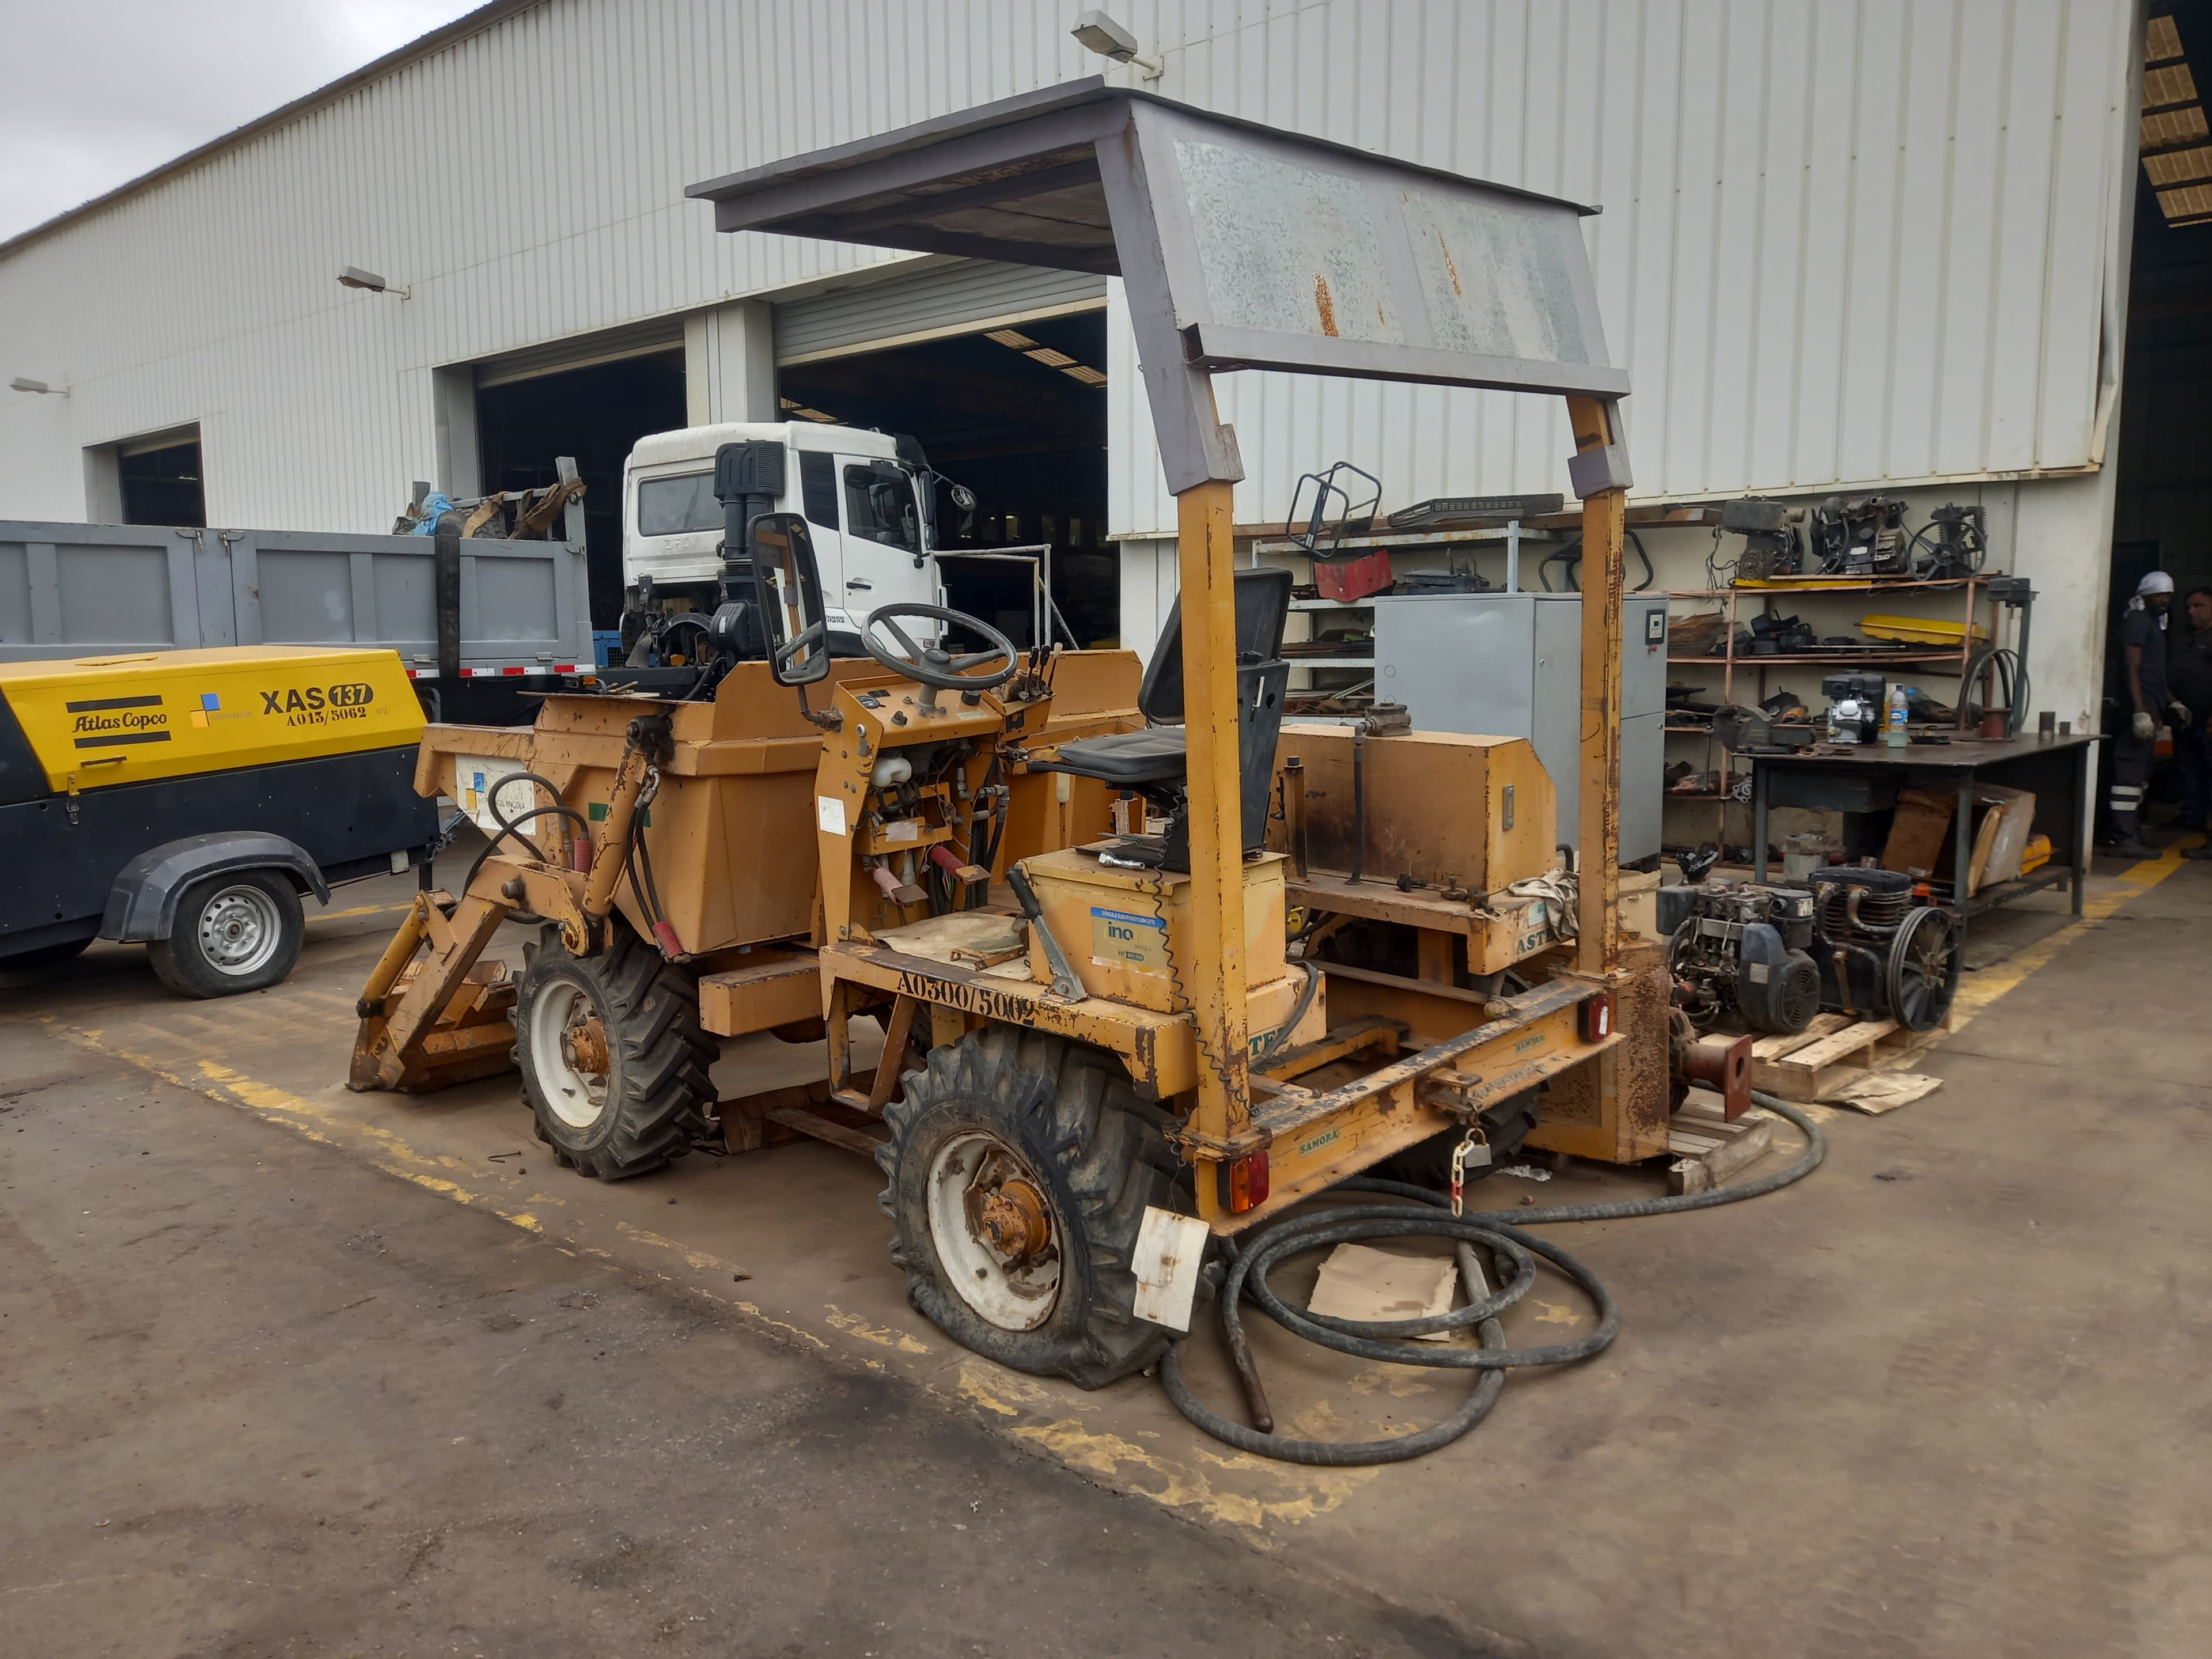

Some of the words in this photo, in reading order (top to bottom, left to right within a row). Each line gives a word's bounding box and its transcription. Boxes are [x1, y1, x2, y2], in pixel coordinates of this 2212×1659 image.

[259, 687, 325, 715] XAS
[332, 684, 367, 706] 137
[72, 715, 121, 733] Atlas
[122, 712, 167, 730] Copco
[287, 706, 367, 726] A013/5062
[1300, 1130, 1338, 1154] SAMORA
